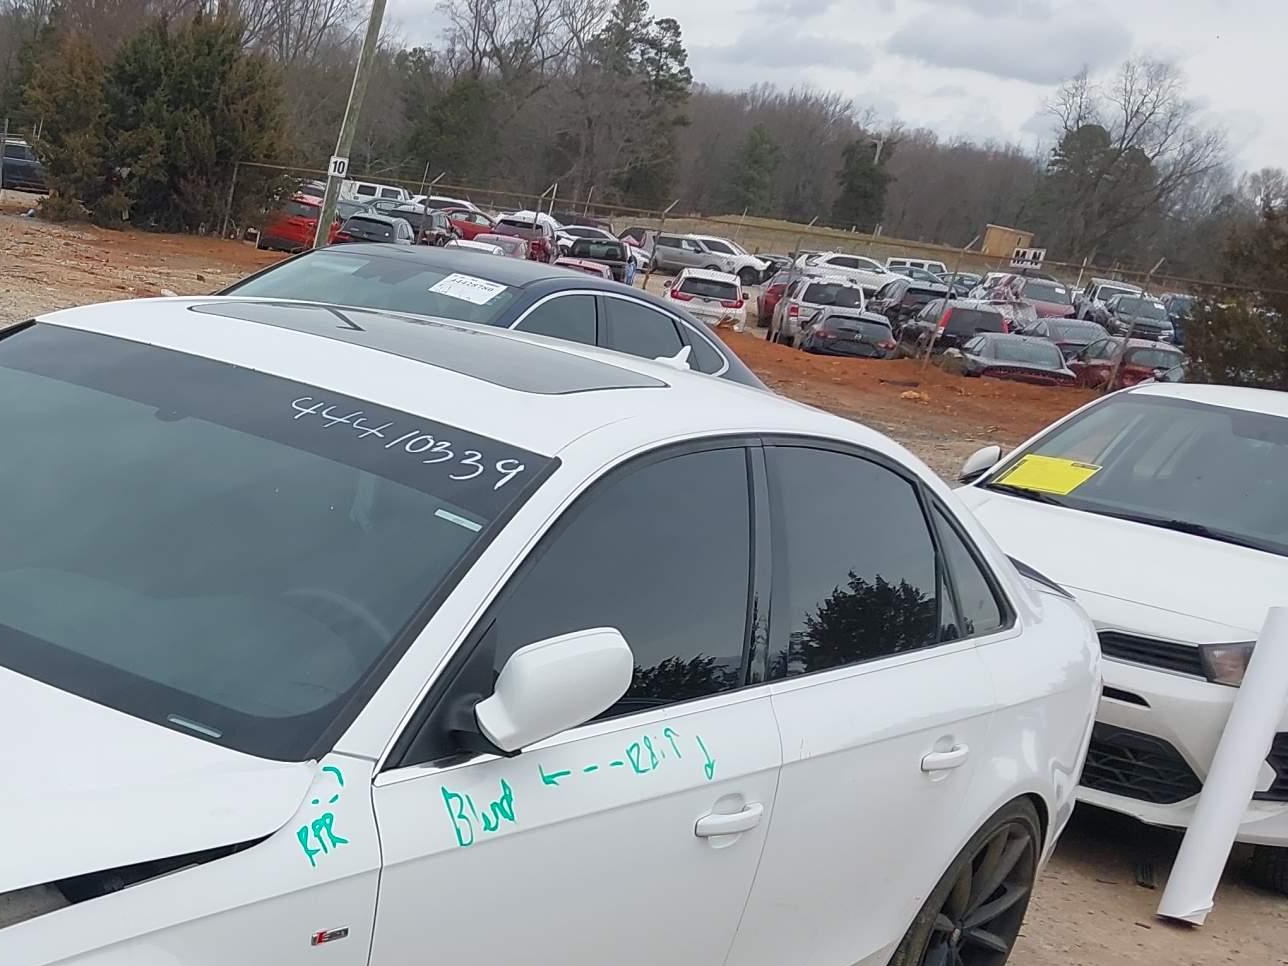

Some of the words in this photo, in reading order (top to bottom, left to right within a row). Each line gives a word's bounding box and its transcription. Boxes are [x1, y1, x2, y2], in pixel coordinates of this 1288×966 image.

[332, 160, 345, 174] 10
[291, 396, 525, 490] 44410339
[297, 811, 349, 868] RPR
